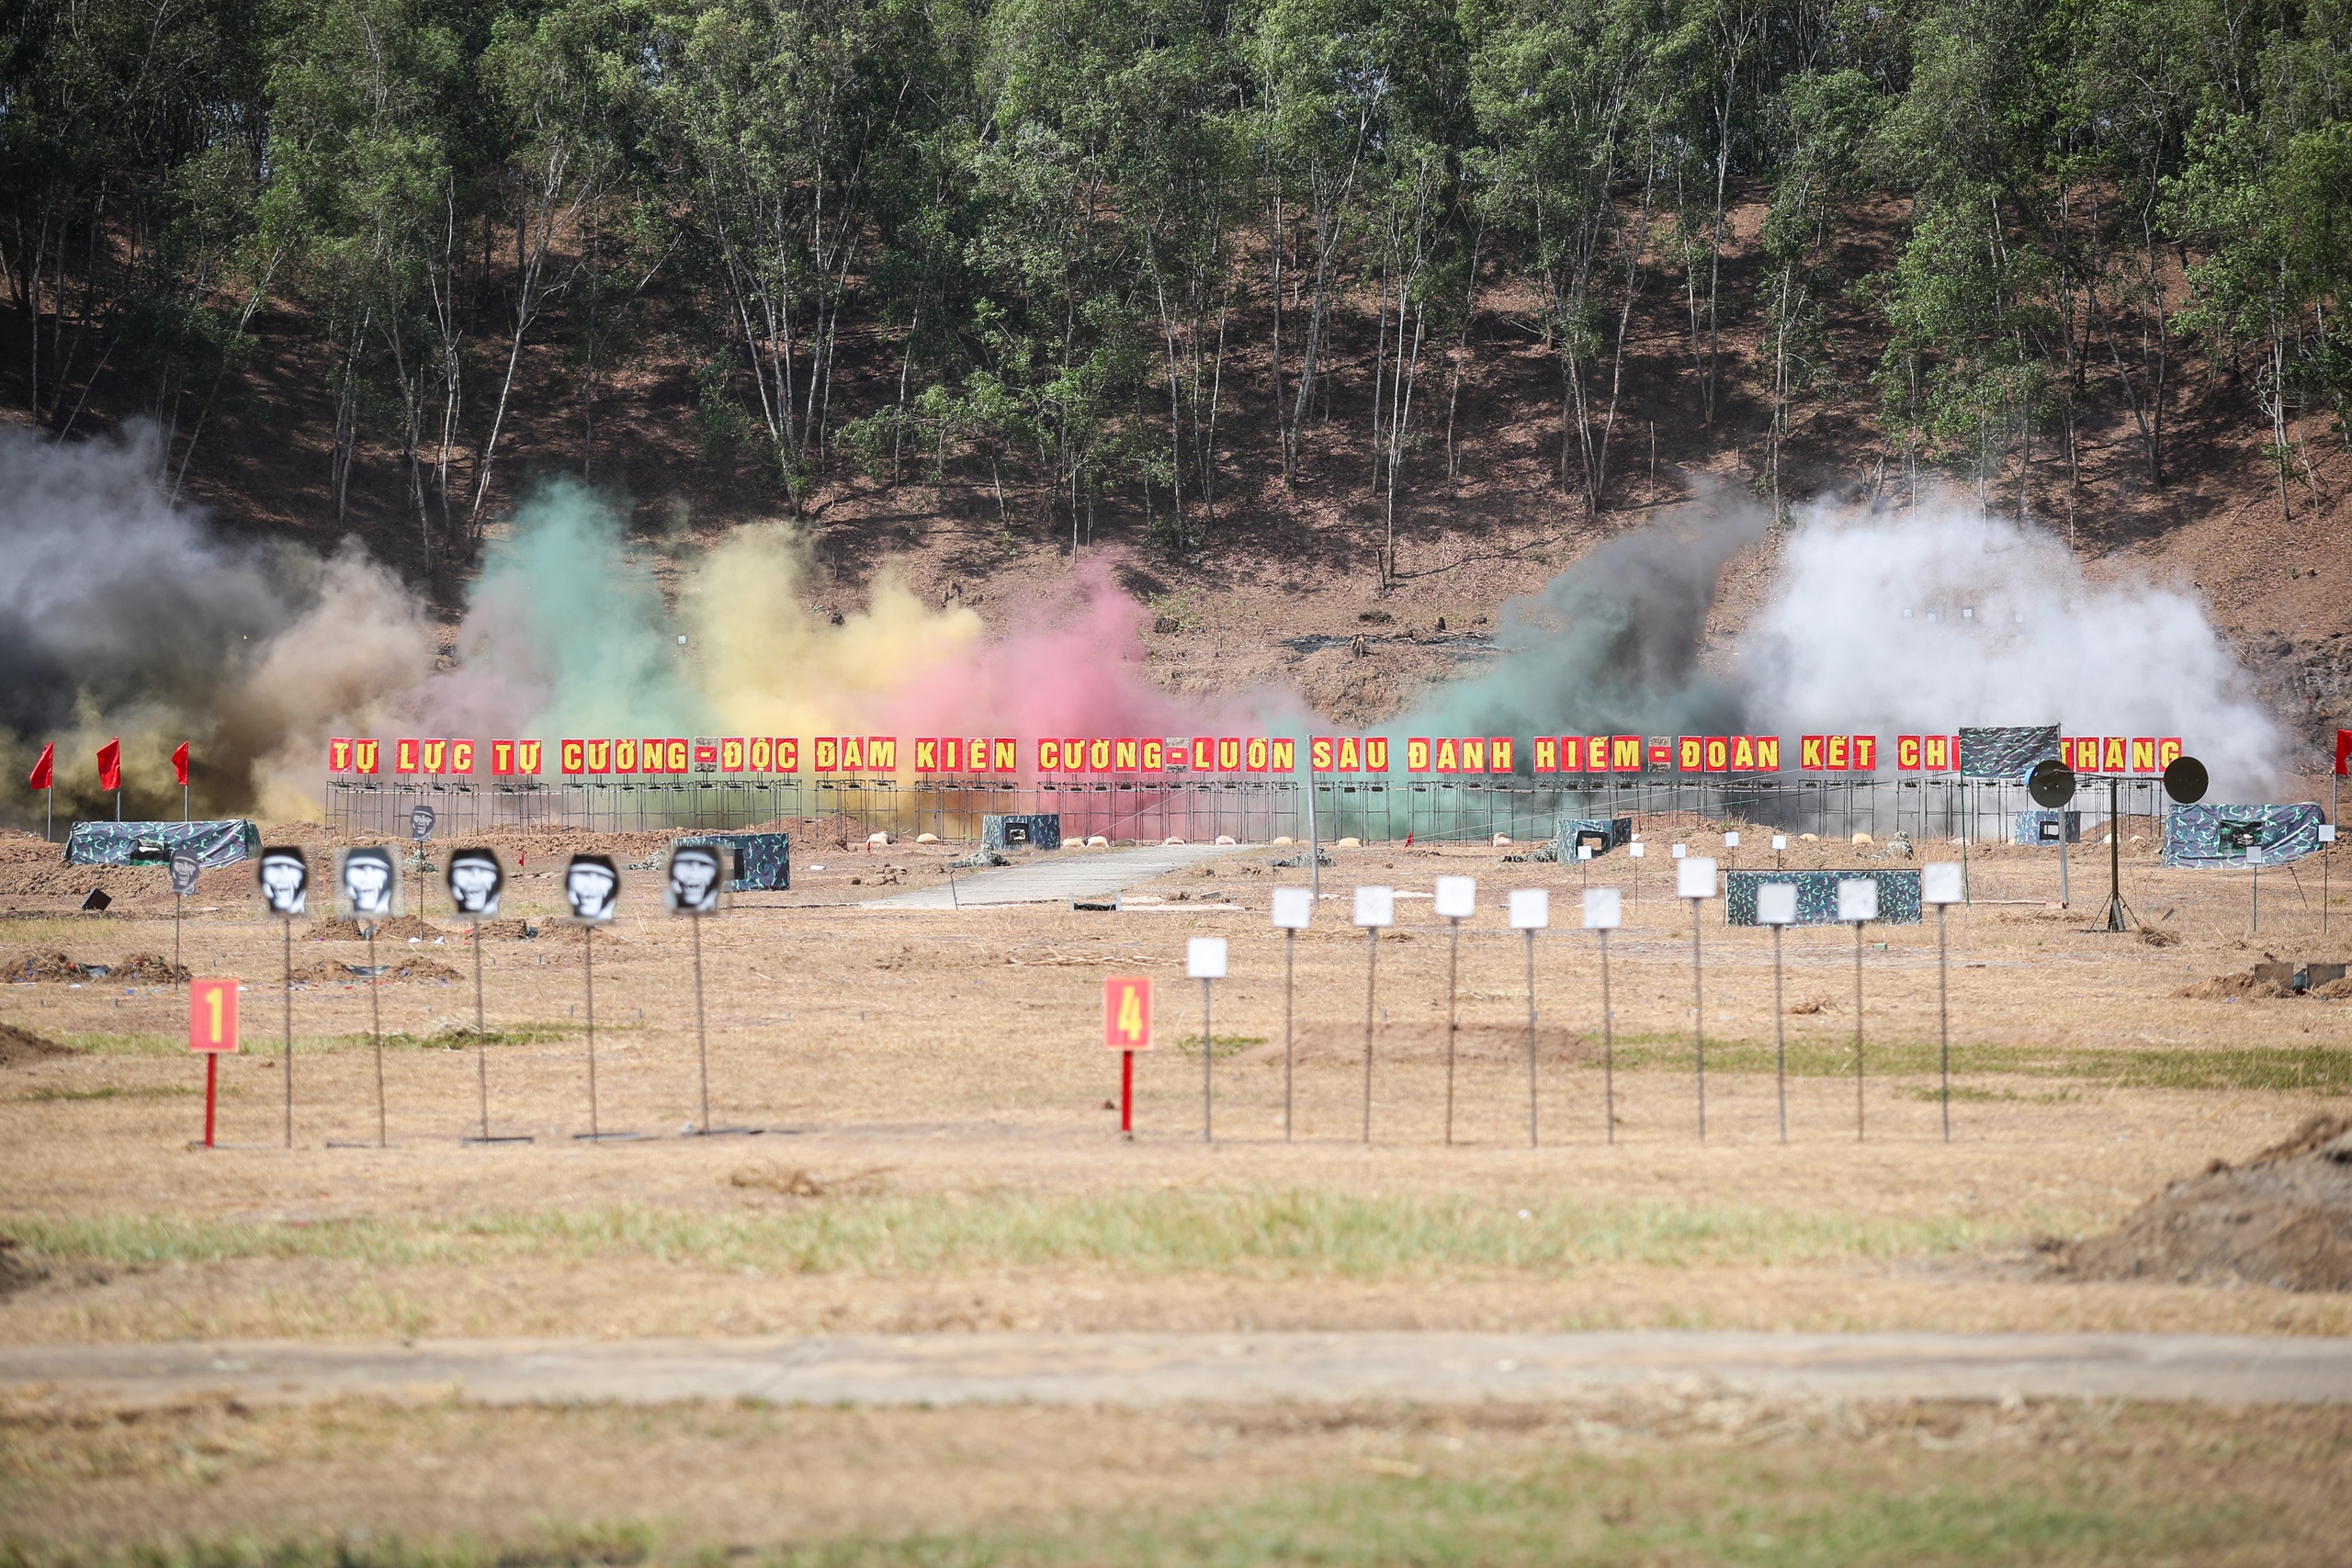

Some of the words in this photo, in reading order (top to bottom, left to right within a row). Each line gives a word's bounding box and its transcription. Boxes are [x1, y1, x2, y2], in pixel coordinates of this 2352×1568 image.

[334, 741, 378, 773] TỰ
[401, 741, 470, 773] LỰC
[495, 741, 540, 773] TỰ
[917, 739, 1014, 768] KIÊN
[1313, 738, 1386, 768] SÂU
[1408, 739, 1510, 768] ĐÁNH
[1803, 736, 1872, 766] KẾT
[206, 987, 222, 1043] 1
[1117, 986, 1143, 1041] 4
